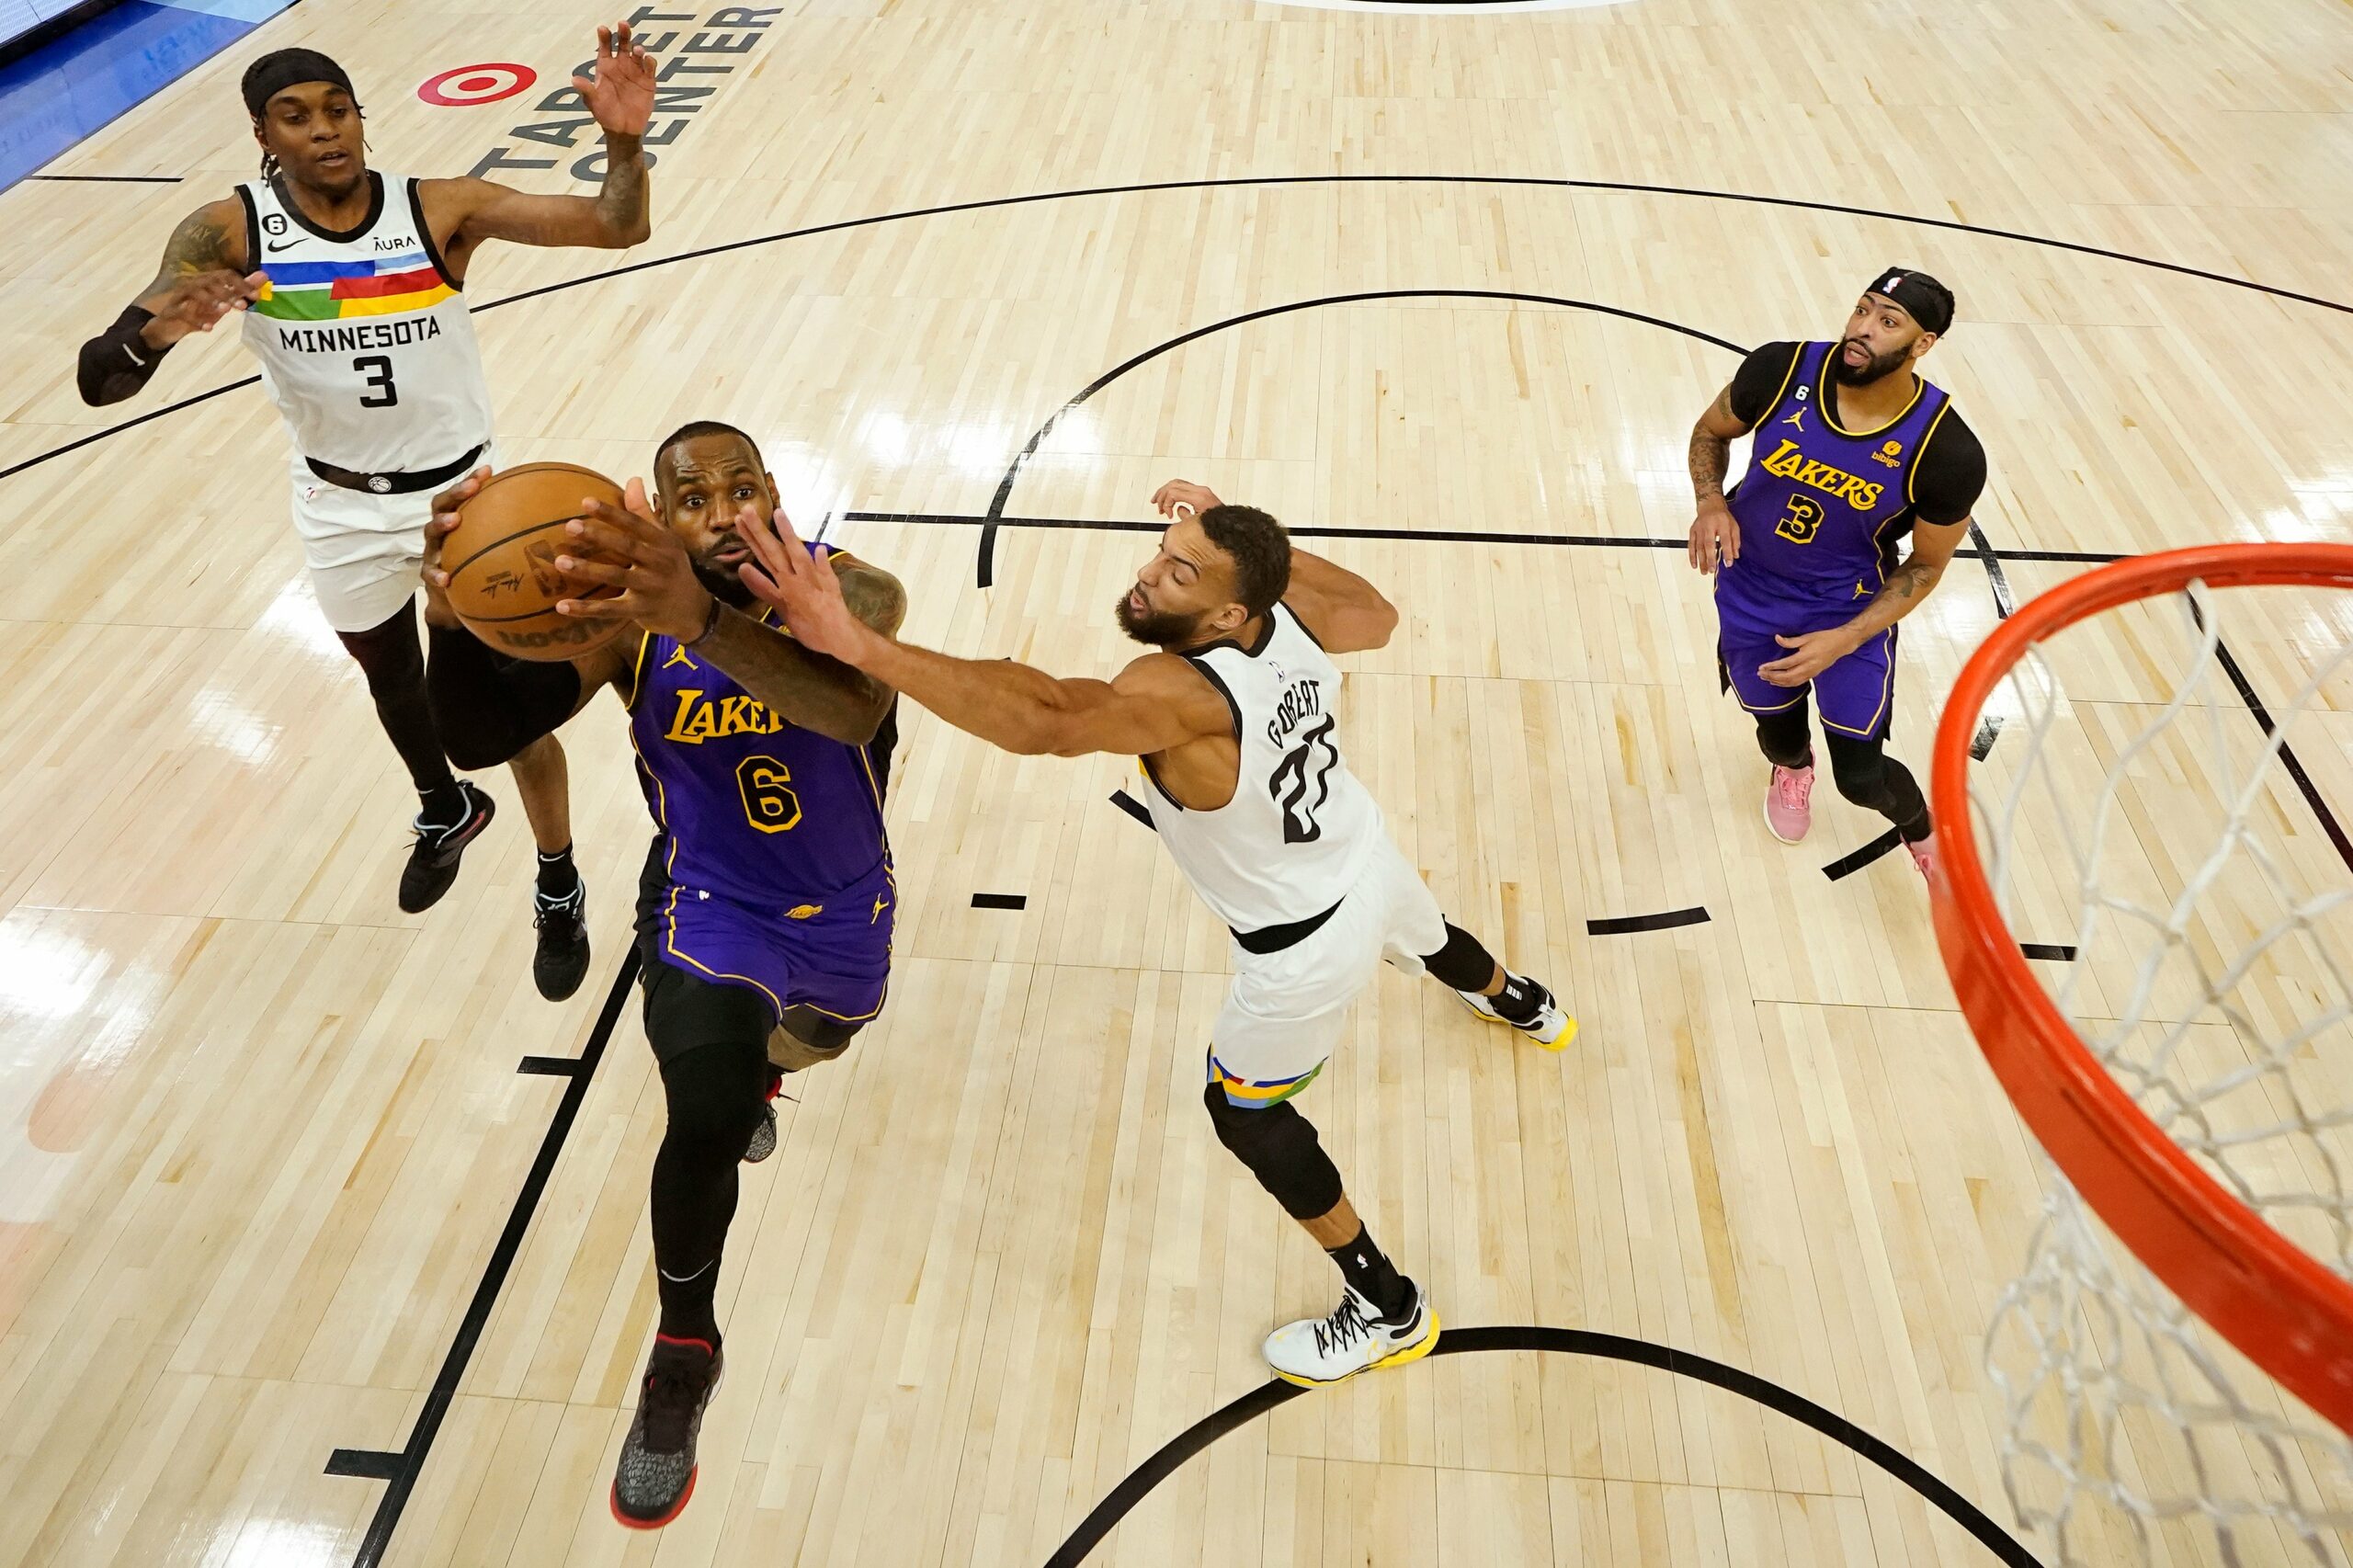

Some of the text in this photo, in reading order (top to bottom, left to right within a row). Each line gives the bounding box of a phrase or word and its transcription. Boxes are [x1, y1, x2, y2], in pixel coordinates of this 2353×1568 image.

[265, 215, 285, 233] 6
[279, 315, 441, 353] MINNESOTA
[353, 355, 398, 408] 3
[1795, 385, 1810, 401] 6
[1759, 438, 1885, 511] LAKERS
[1871, 451, 1901, 468] bibigo
[1775, 493, 1824, 545] 3
[664, 689, 784, 744] LAKE
[1267, 679, 1320, 749] GOBERT
[735, 754, 802, 835] 6
